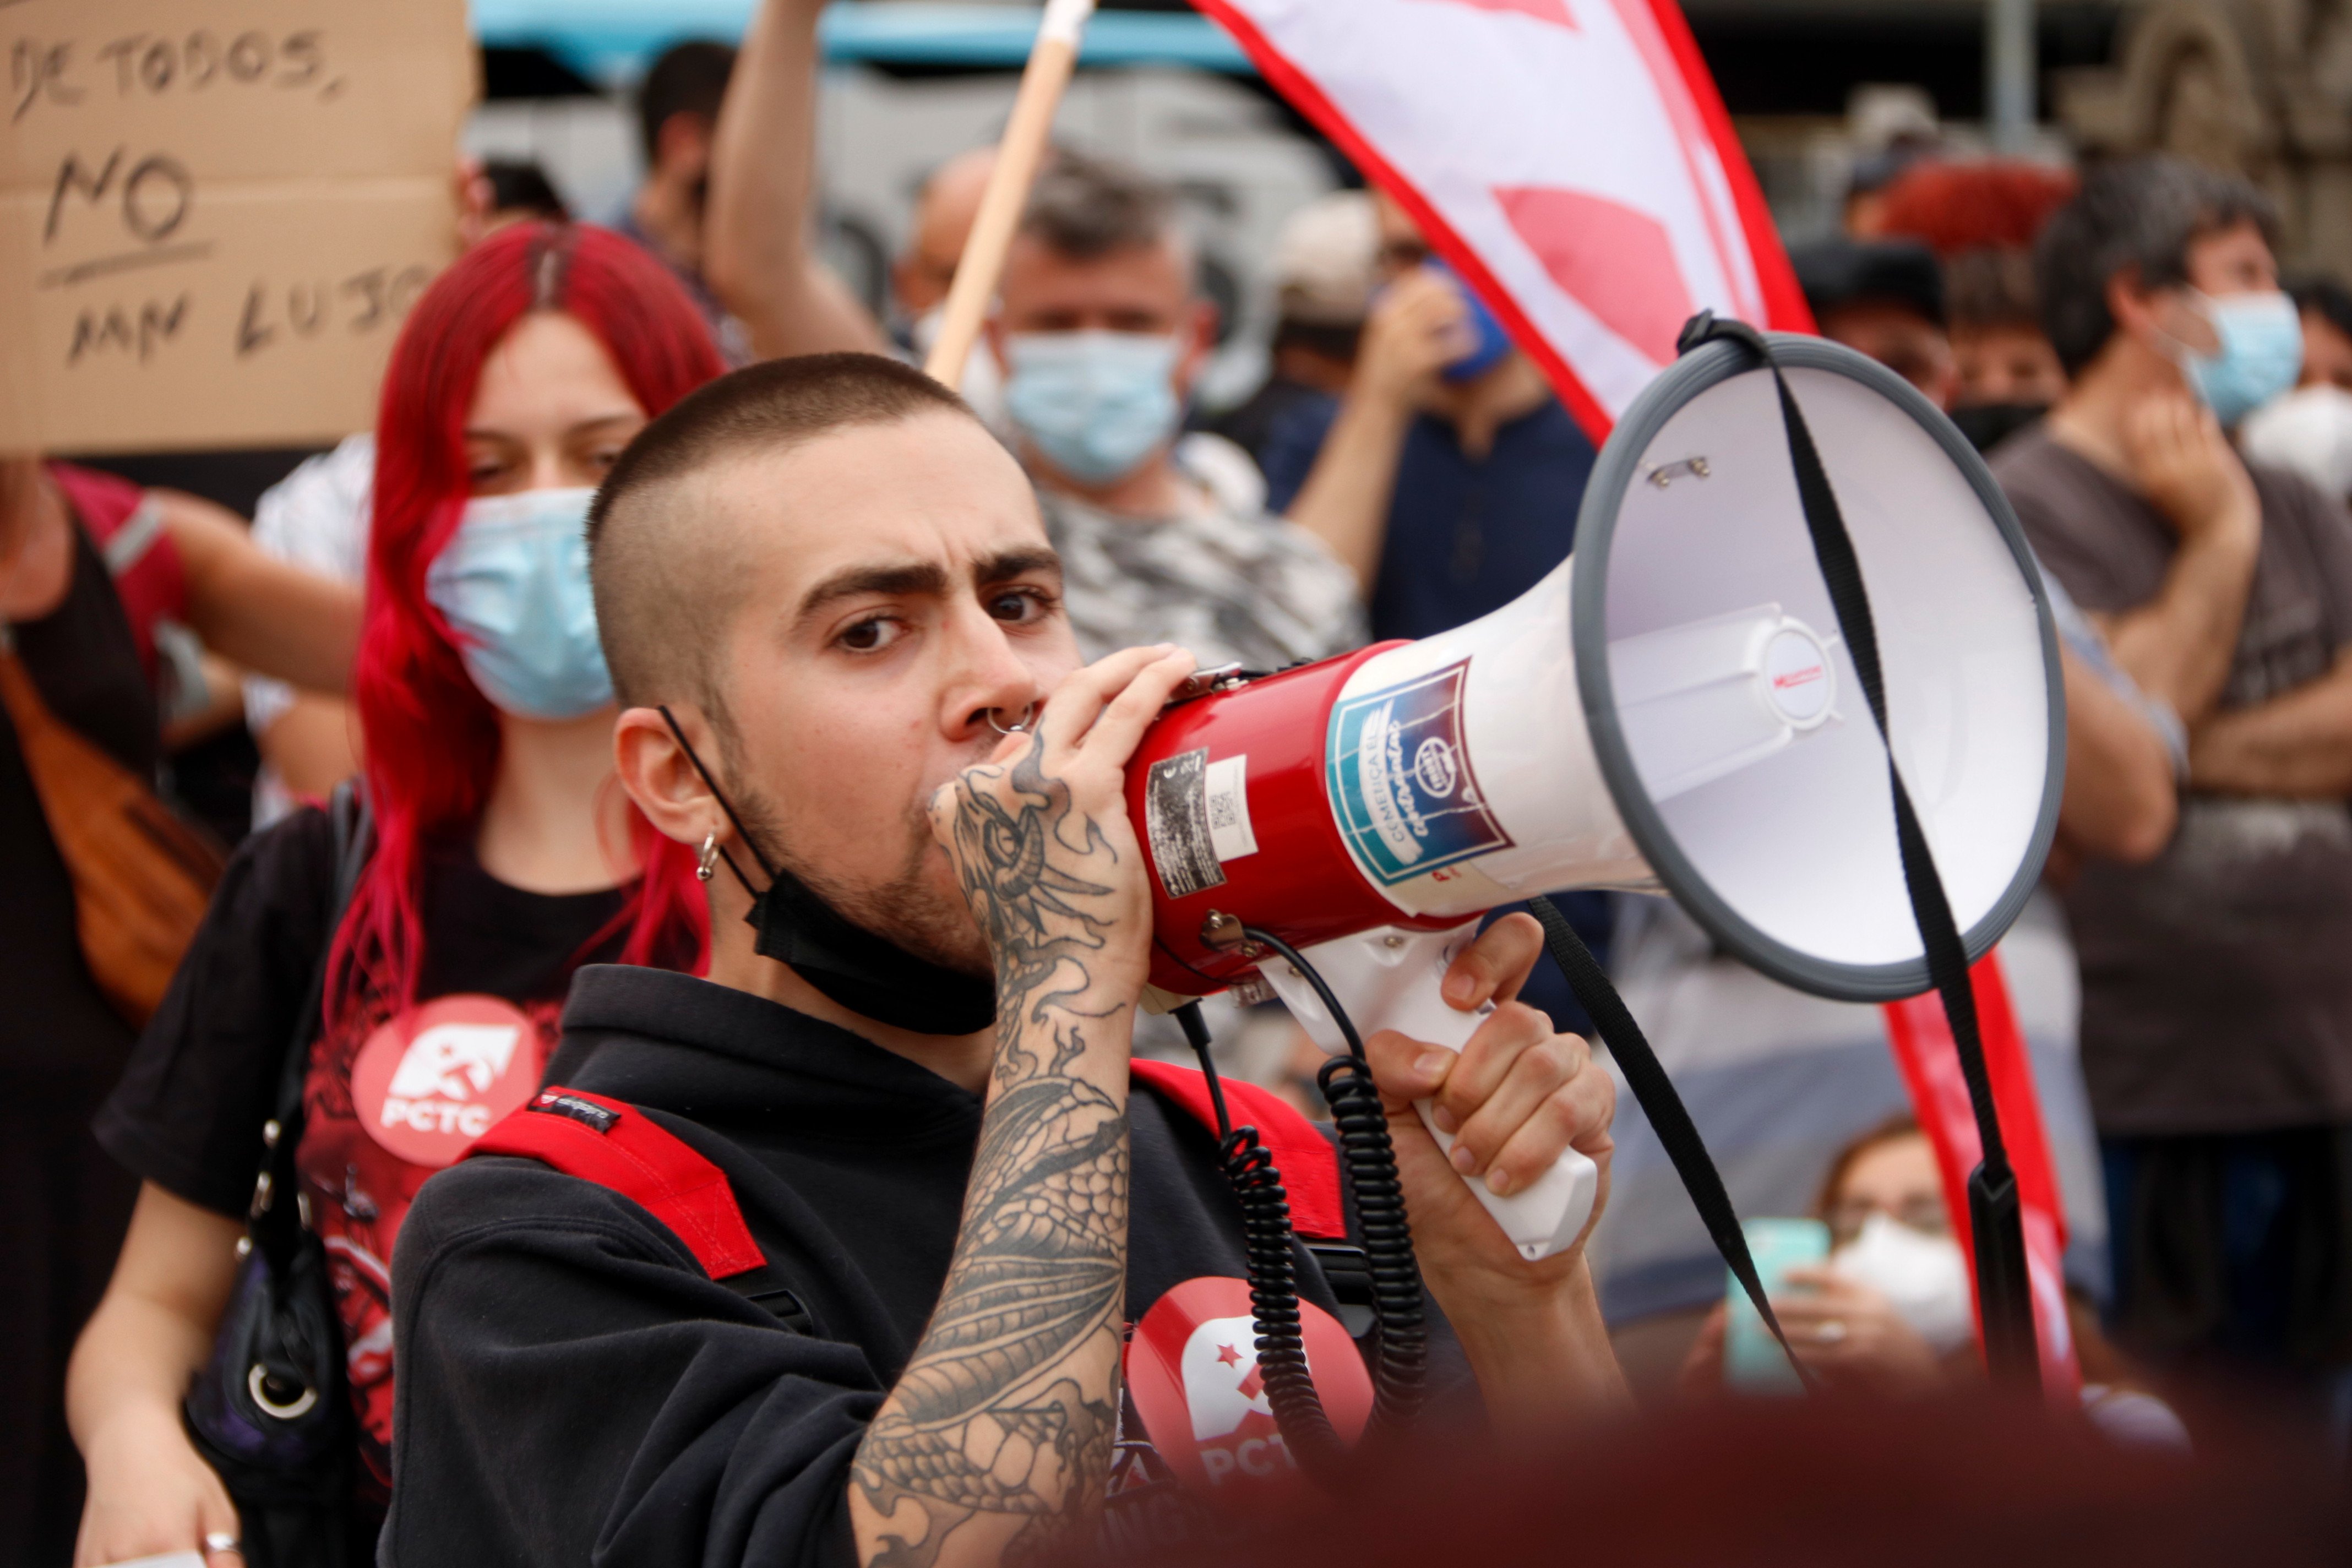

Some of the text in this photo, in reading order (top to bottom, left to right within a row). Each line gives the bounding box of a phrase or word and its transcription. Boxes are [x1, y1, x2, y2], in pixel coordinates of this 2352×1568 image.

[10, 37, 84, 124] DE
[43, 145, 194, 246] NO
[380, 1097, 491, 1137] PCTC
[1199, 1433, 1298, 1485] PCT
